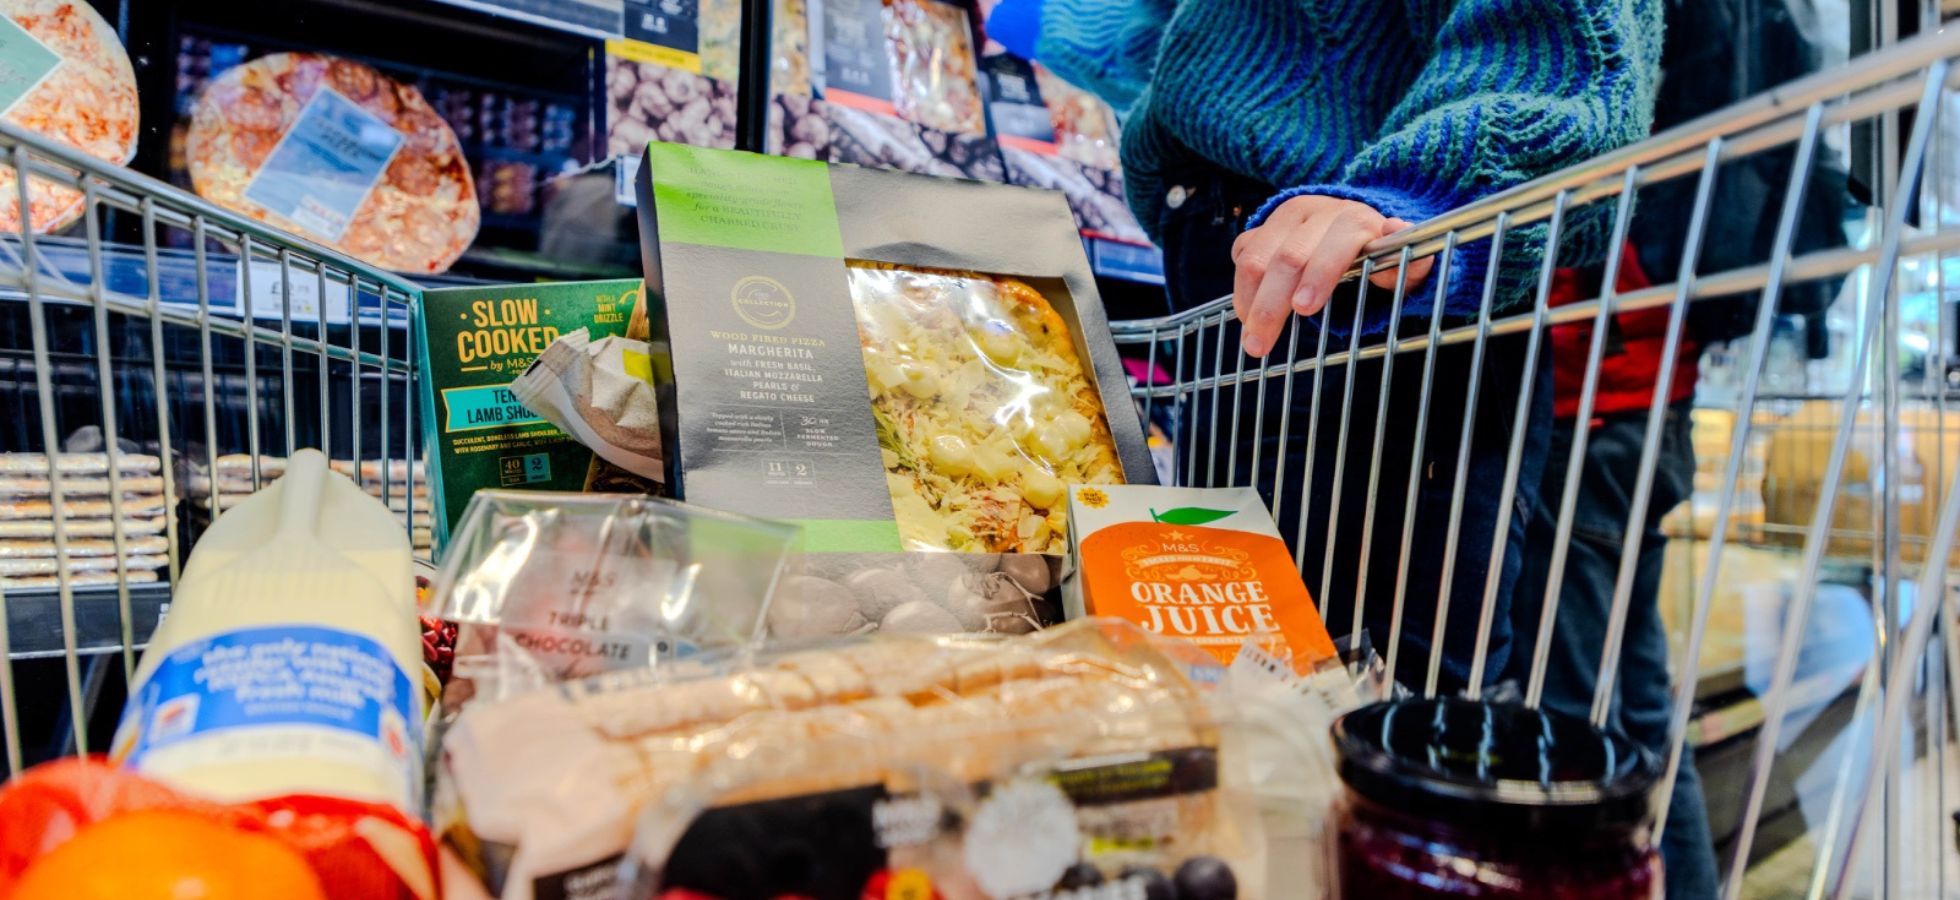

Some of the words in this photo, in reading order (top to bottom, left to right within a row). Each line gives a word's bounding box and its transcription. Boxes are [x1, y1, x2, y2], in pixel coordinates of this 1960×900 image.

[700, 215, 760, 229] CHARRED
[737, 298, 789, 308] COLLECTION
[472, 298, 538, 328] SLOW
[594, 312, 625, 324] DRIZZLE
[457, 326, 560, 363] COOKED
[710, 330, 748, 341] WOOD
[752, 333, 788, 344] FIRED
[791, 337, 827, 347] PIZZA
[728, 343, 814, 359] MARGHERITA
[490, 360, 503, 372] by
[506, 357, 534, 369] M&S
[730, 360, 752, 368] with
[755, 360, 784, 369] FRESH
[724, 368, 761, 378] ITALIAN
[764, 371, 823, 383] MOZZARELLA
[753, 381, 788, 391] PEARLS
[492, 389, 517, 404] TEN
[740, 391, 777, 400] REGATO
[780, 393, 815, 403] CHEESE
[467, 406, 503, 424] LAMB
[800, 416, 817, 426] 30
[796, 433, 839, 441] FERMENTED
[504, 458, 521, 470] 40
[531, 457, 544, 471] 2
[768, 462, 782, 472] 11
[795, 463, 808, 476] 2
[1162, 542, 1199, 553] M&S
[1130, 580, 1269, 605] ORANGE
[548, 609, 609, 632] TRIPLE
[1140, 603, 1281, 635] JUICE
[514, 632, 632, 660] CHOCOLATE
